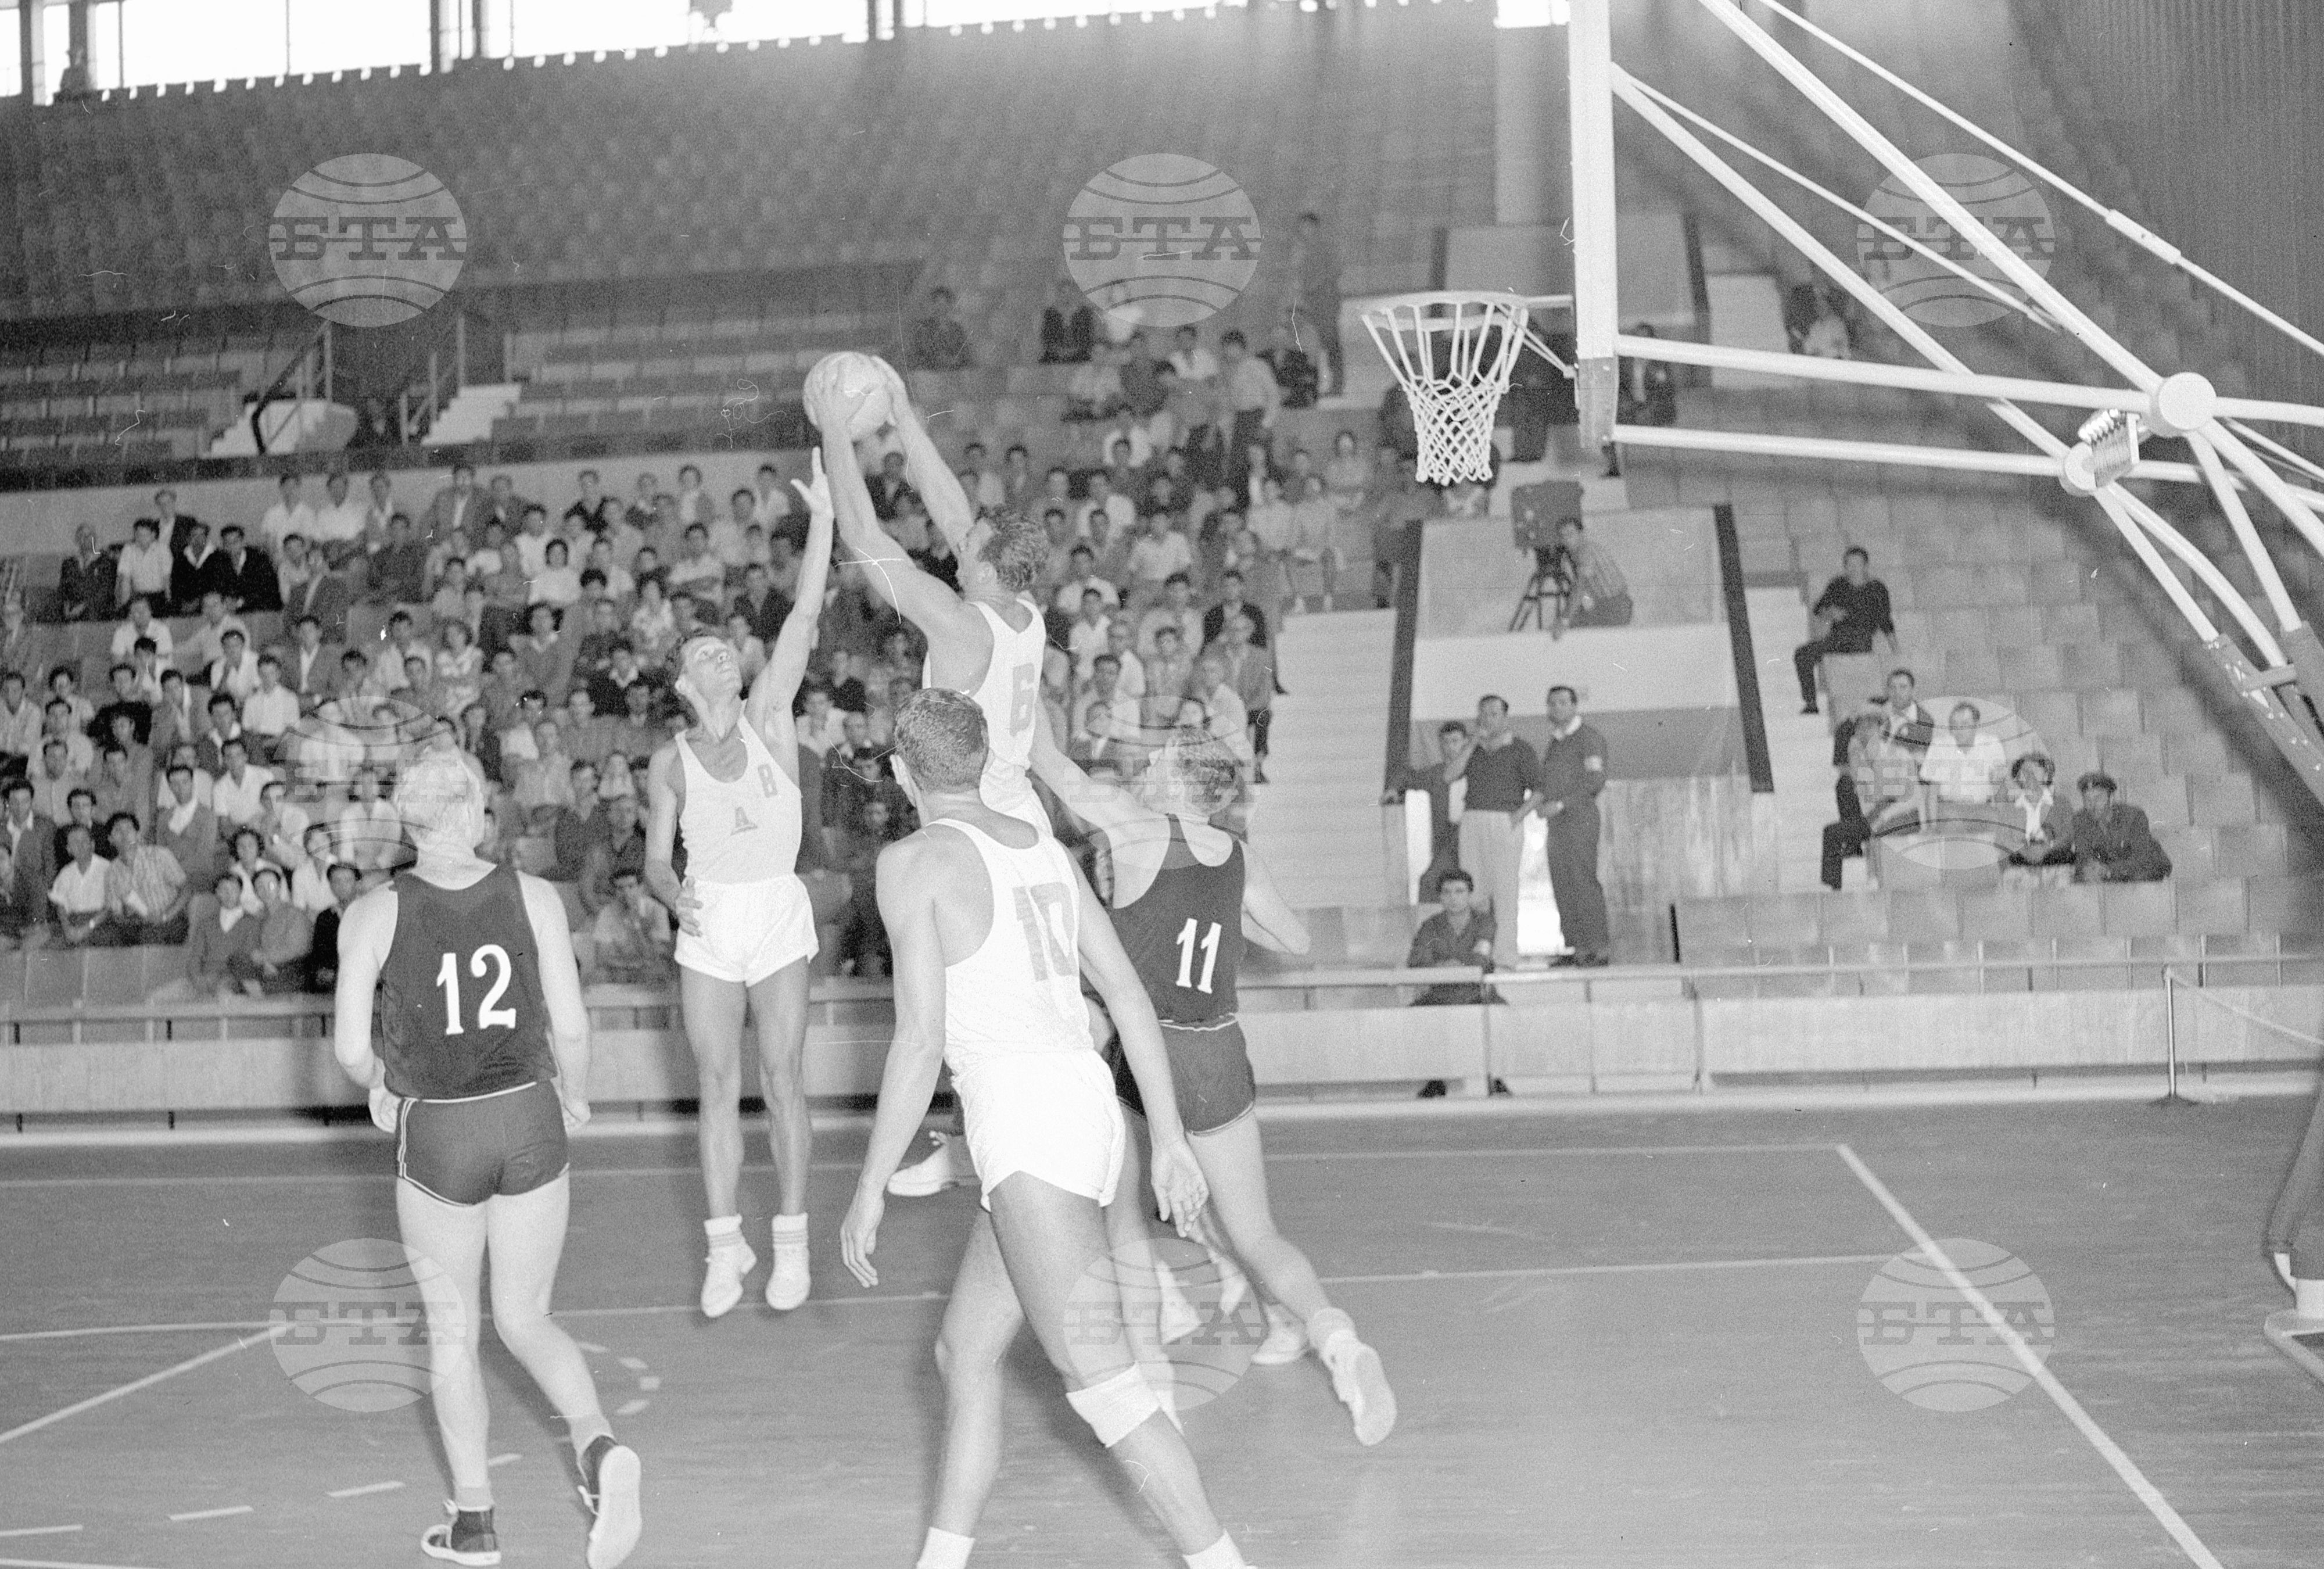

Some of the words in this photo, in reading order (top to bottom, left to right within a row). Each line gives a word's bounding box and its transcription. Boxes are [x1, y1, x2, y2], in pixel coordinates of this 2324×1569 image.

[1009, 662, 1035, 737] 6
[1012, 882, 1079, 982] 10
[1175, 918, 1222, 994] 11
[437, 944, 517, 1035] 12
